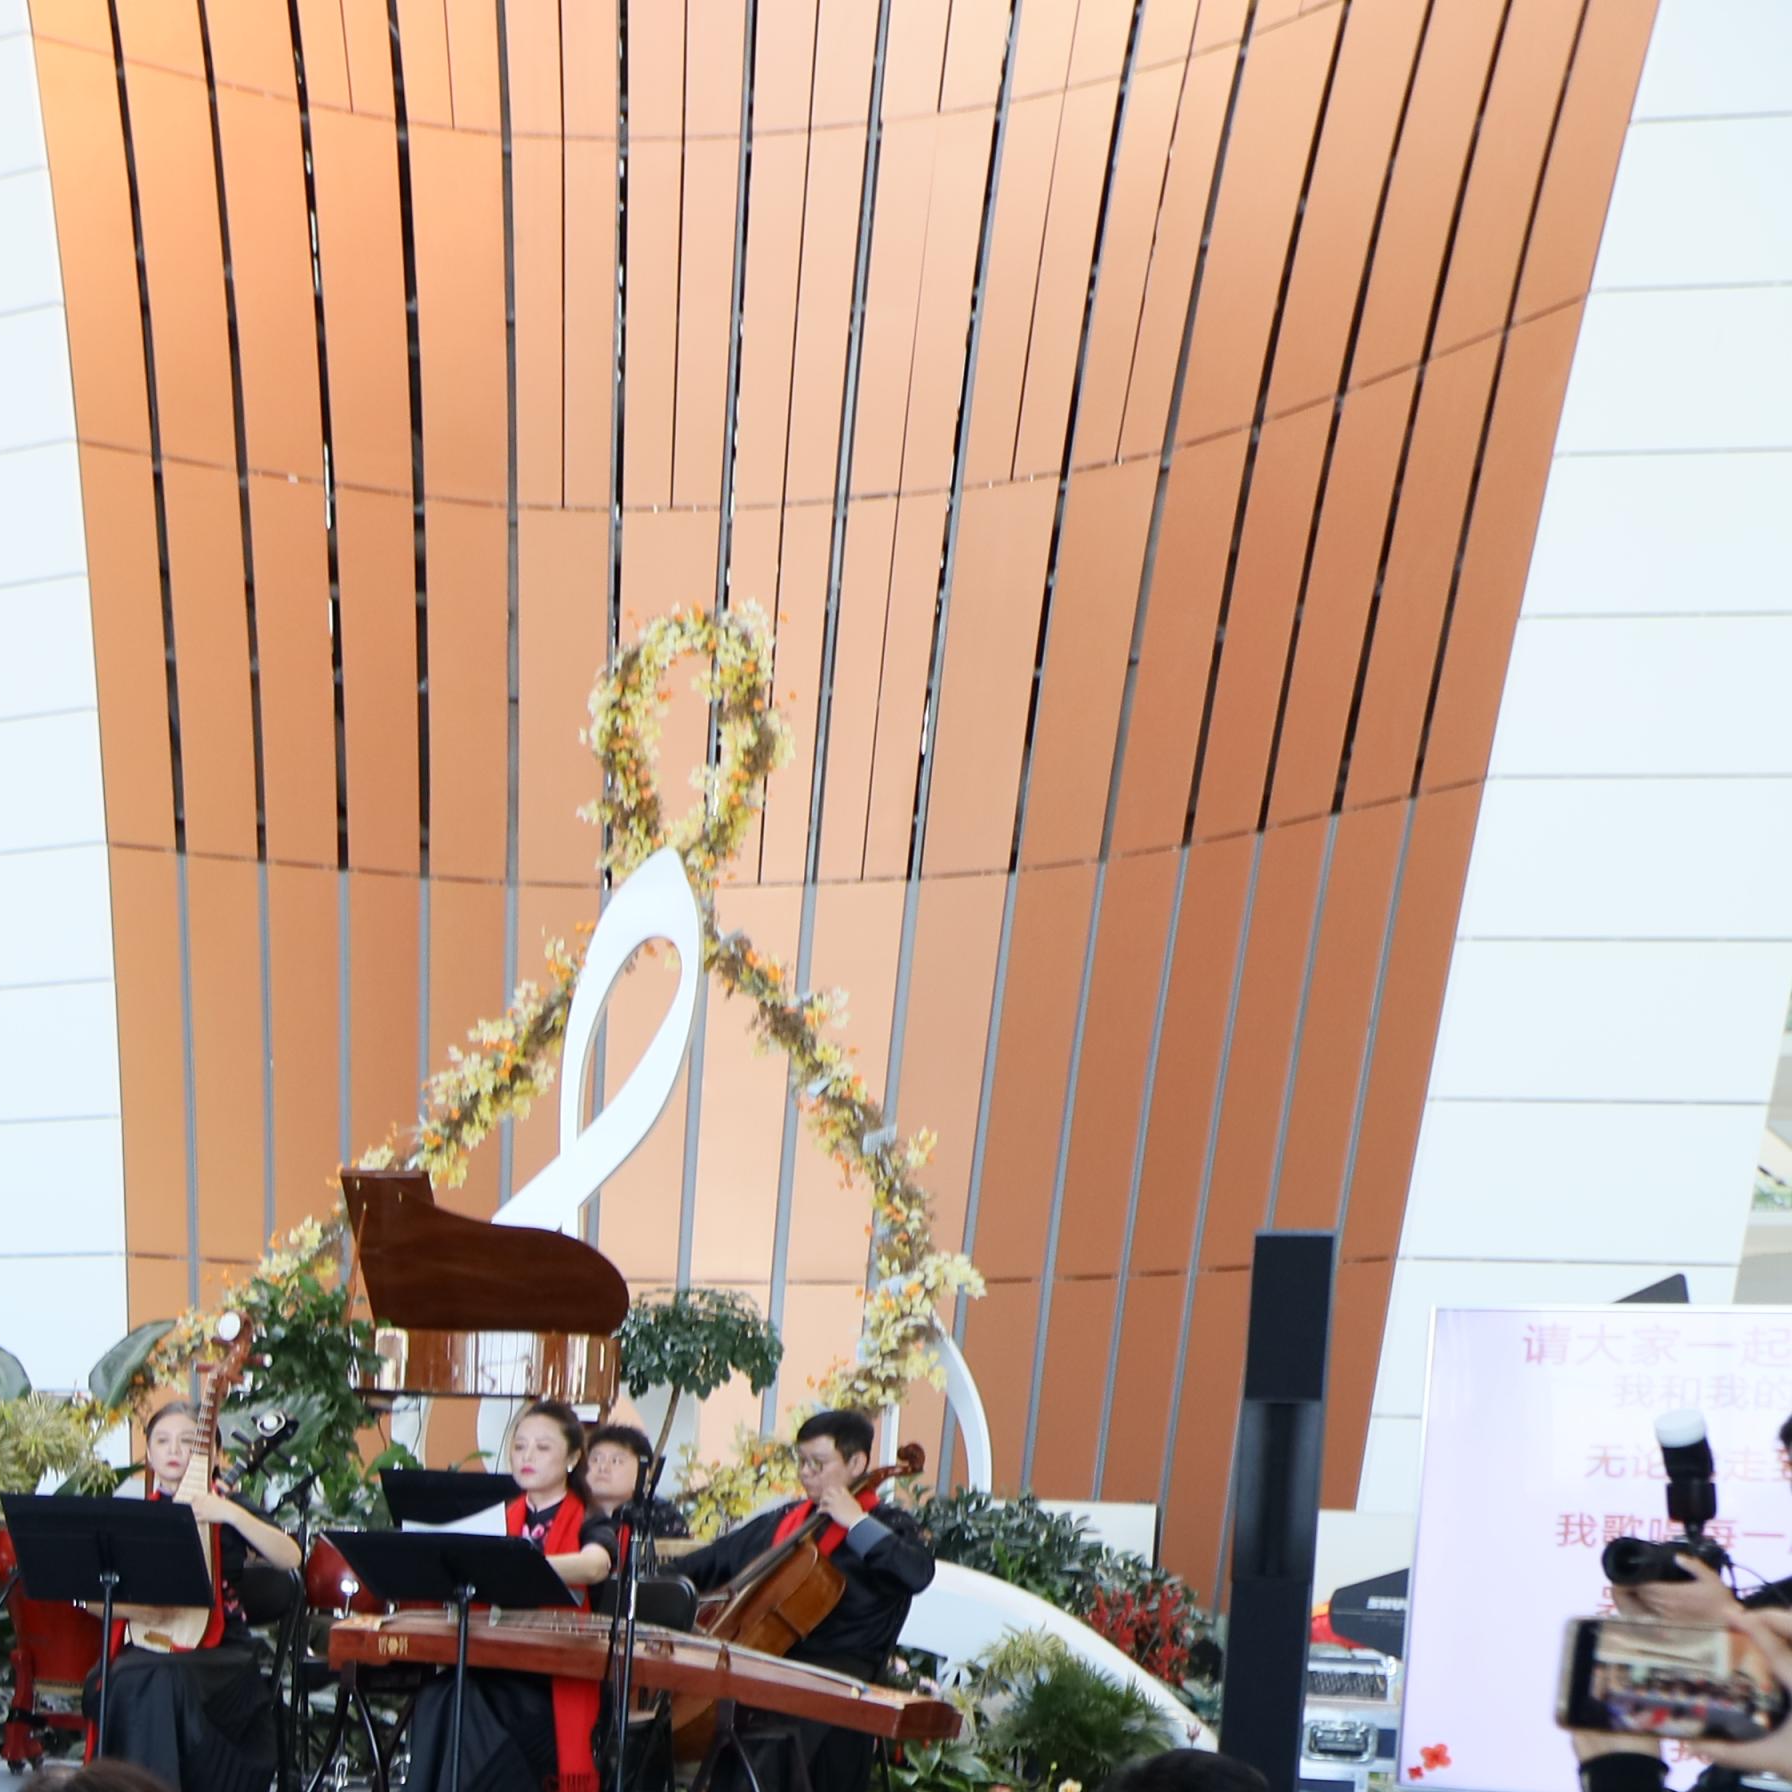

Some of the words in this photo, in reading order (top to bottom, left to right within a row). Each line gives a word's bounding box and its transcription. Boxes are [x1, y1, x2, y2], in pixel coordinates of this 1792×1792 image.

[1522, 1322, 1792, 1367] 请大家一起
